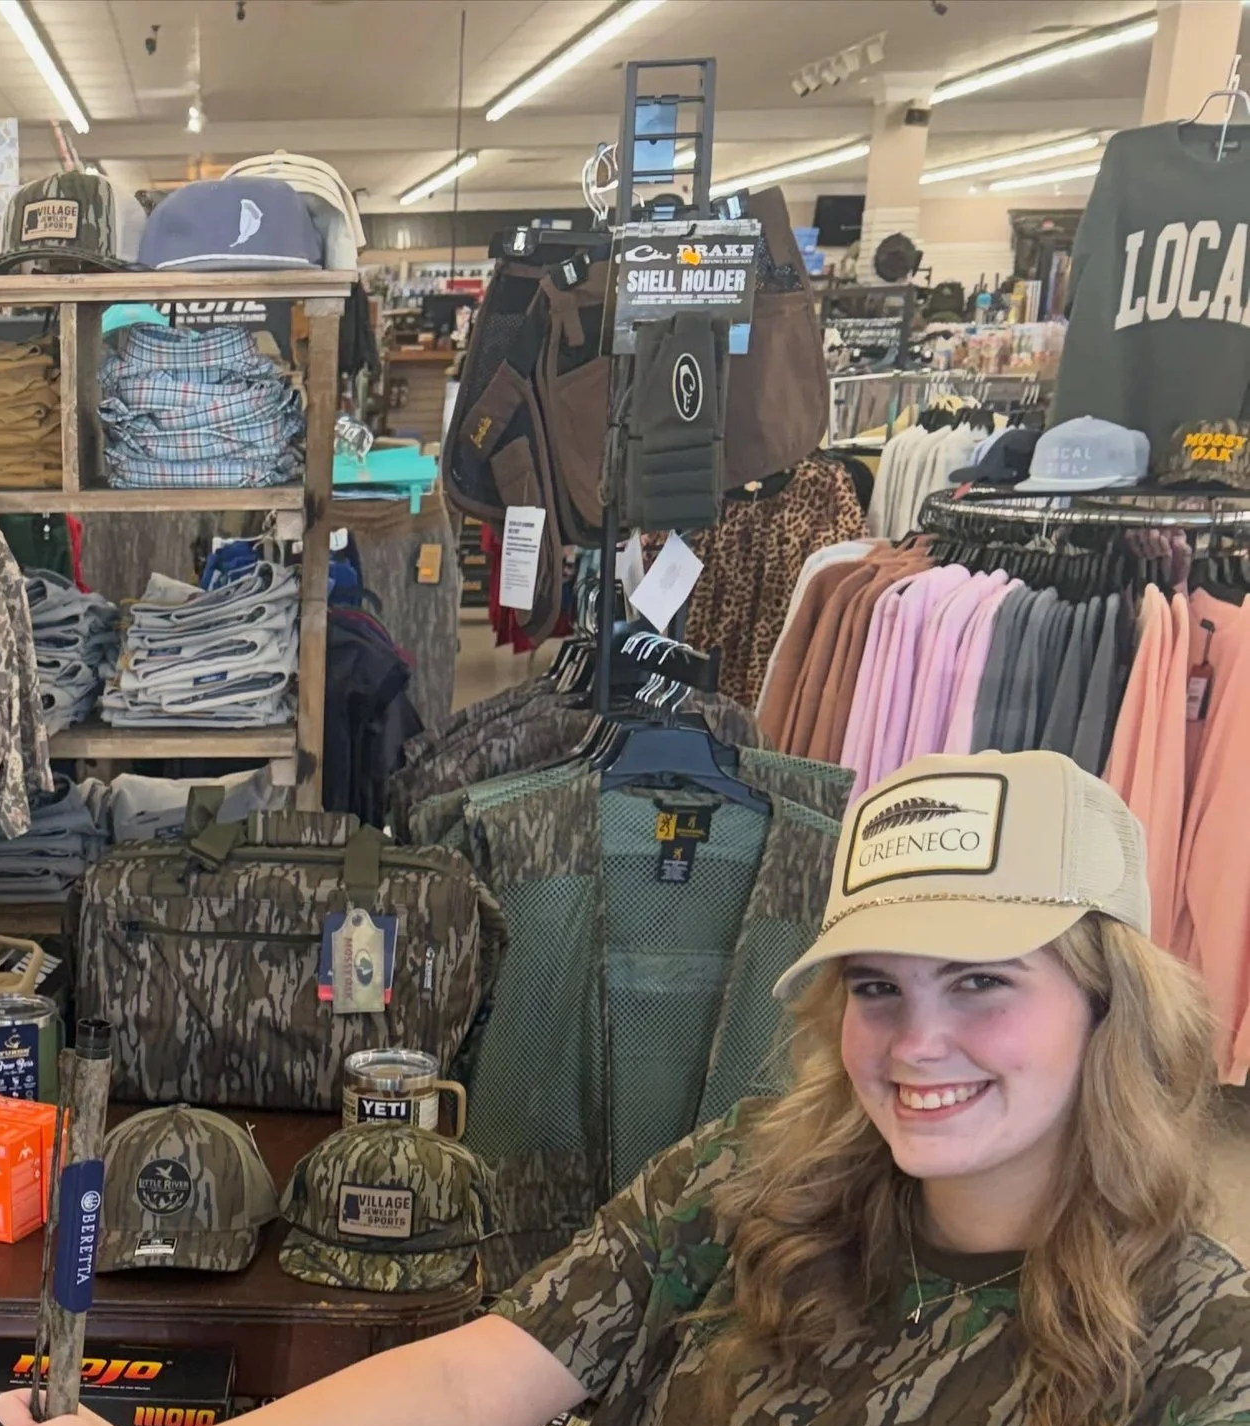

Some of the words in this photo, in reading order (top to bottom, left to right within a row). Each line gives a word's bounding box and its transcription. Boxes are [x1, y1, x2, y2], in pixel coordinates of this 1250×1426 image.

[36, 205, 78, 217] VILLAGE
[677, 244, 755, 257] DRAKE
[626, 269, 677, 293] SHELL
[681, 269, 746, 292] HOLDER
[1114, 220, 1250, 332] LOCA
[1183, 432, 1248, 449] MOSSY
[1190, 446, 1235, 463] OAK
[362, 1100, 406, 1116] YETI
[138, 1178, 162, 1190] LITTLE
[164, 1177, 190, 1190] RIVER
[358, 1193, 411, 1210] VILLAGE
[362, 1208, 399, 1218] JEWELRY
[368, 1216, 406, 1226] SPORTS
[76, 1213, 97, 1286] BERETTA
